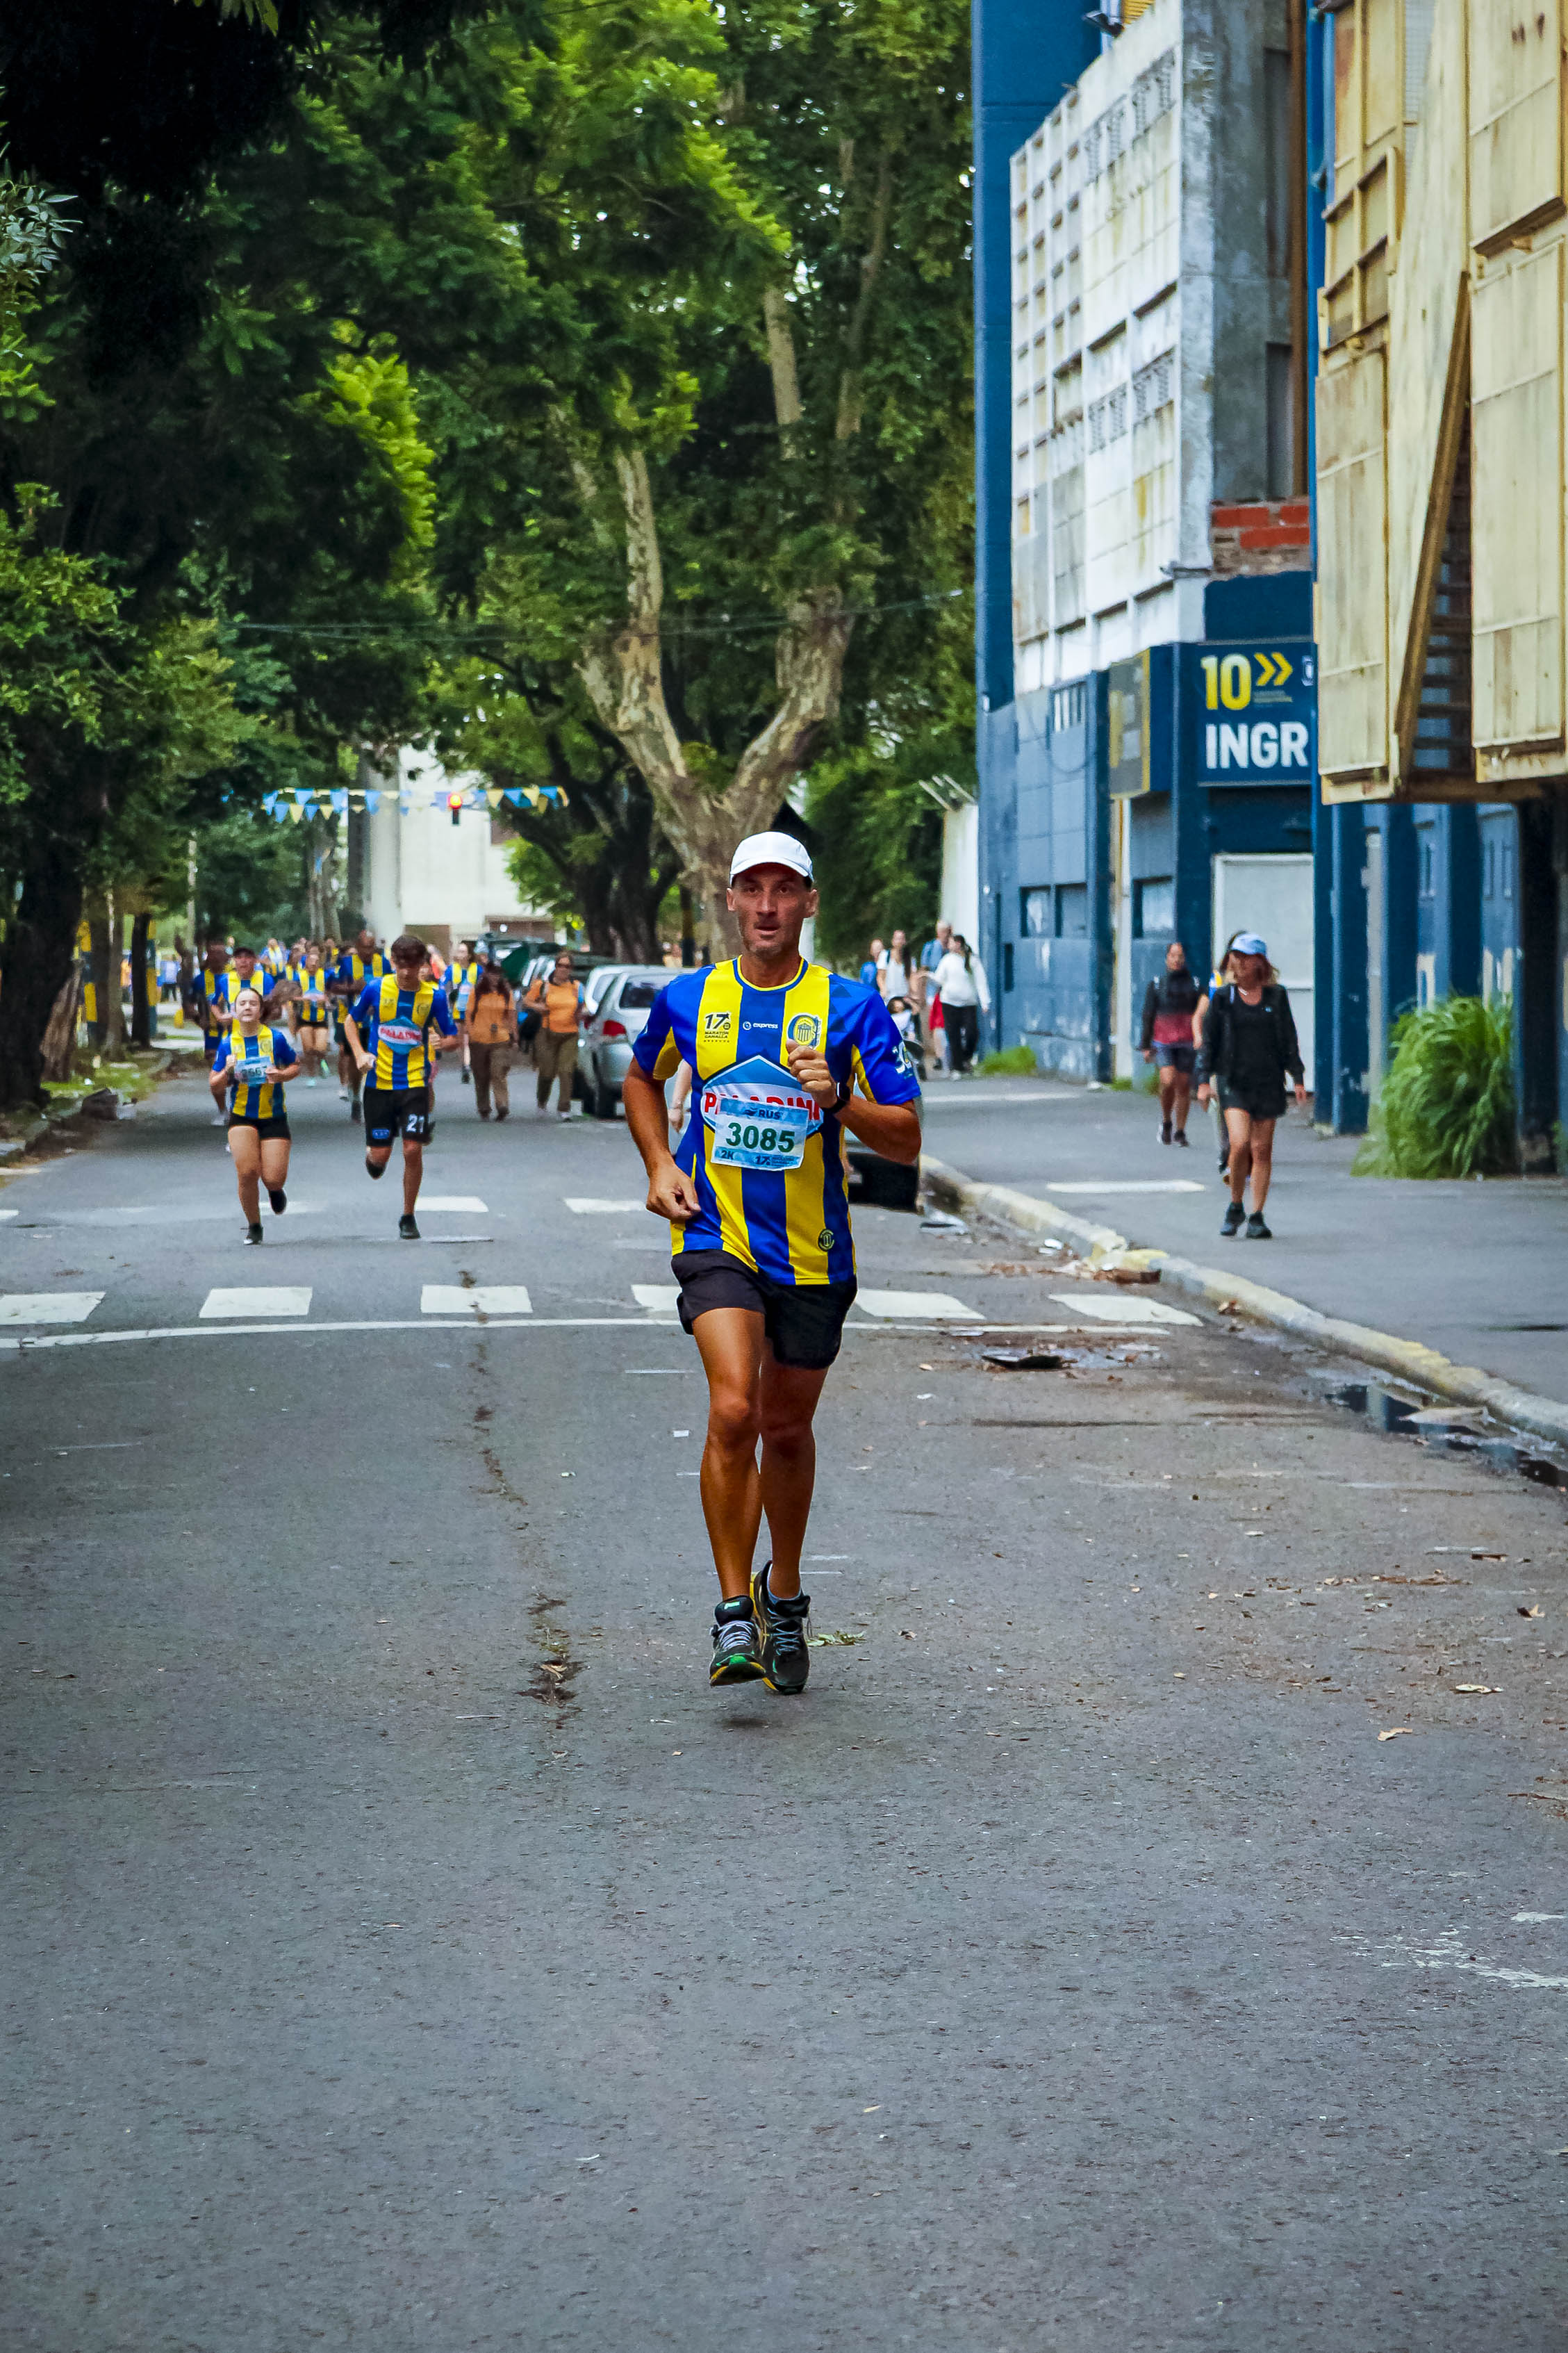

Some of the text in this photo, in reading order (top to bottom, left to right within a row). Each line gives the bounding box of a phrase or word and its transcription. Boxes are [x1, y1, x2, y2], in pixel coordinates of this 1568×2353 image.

[1200, 654, 1251, 710] 10
[705, 1012, 729, 1029] 17
[758, 1109, 781, 1120] RUS
[725, 1122, 795, 1153] 3085
